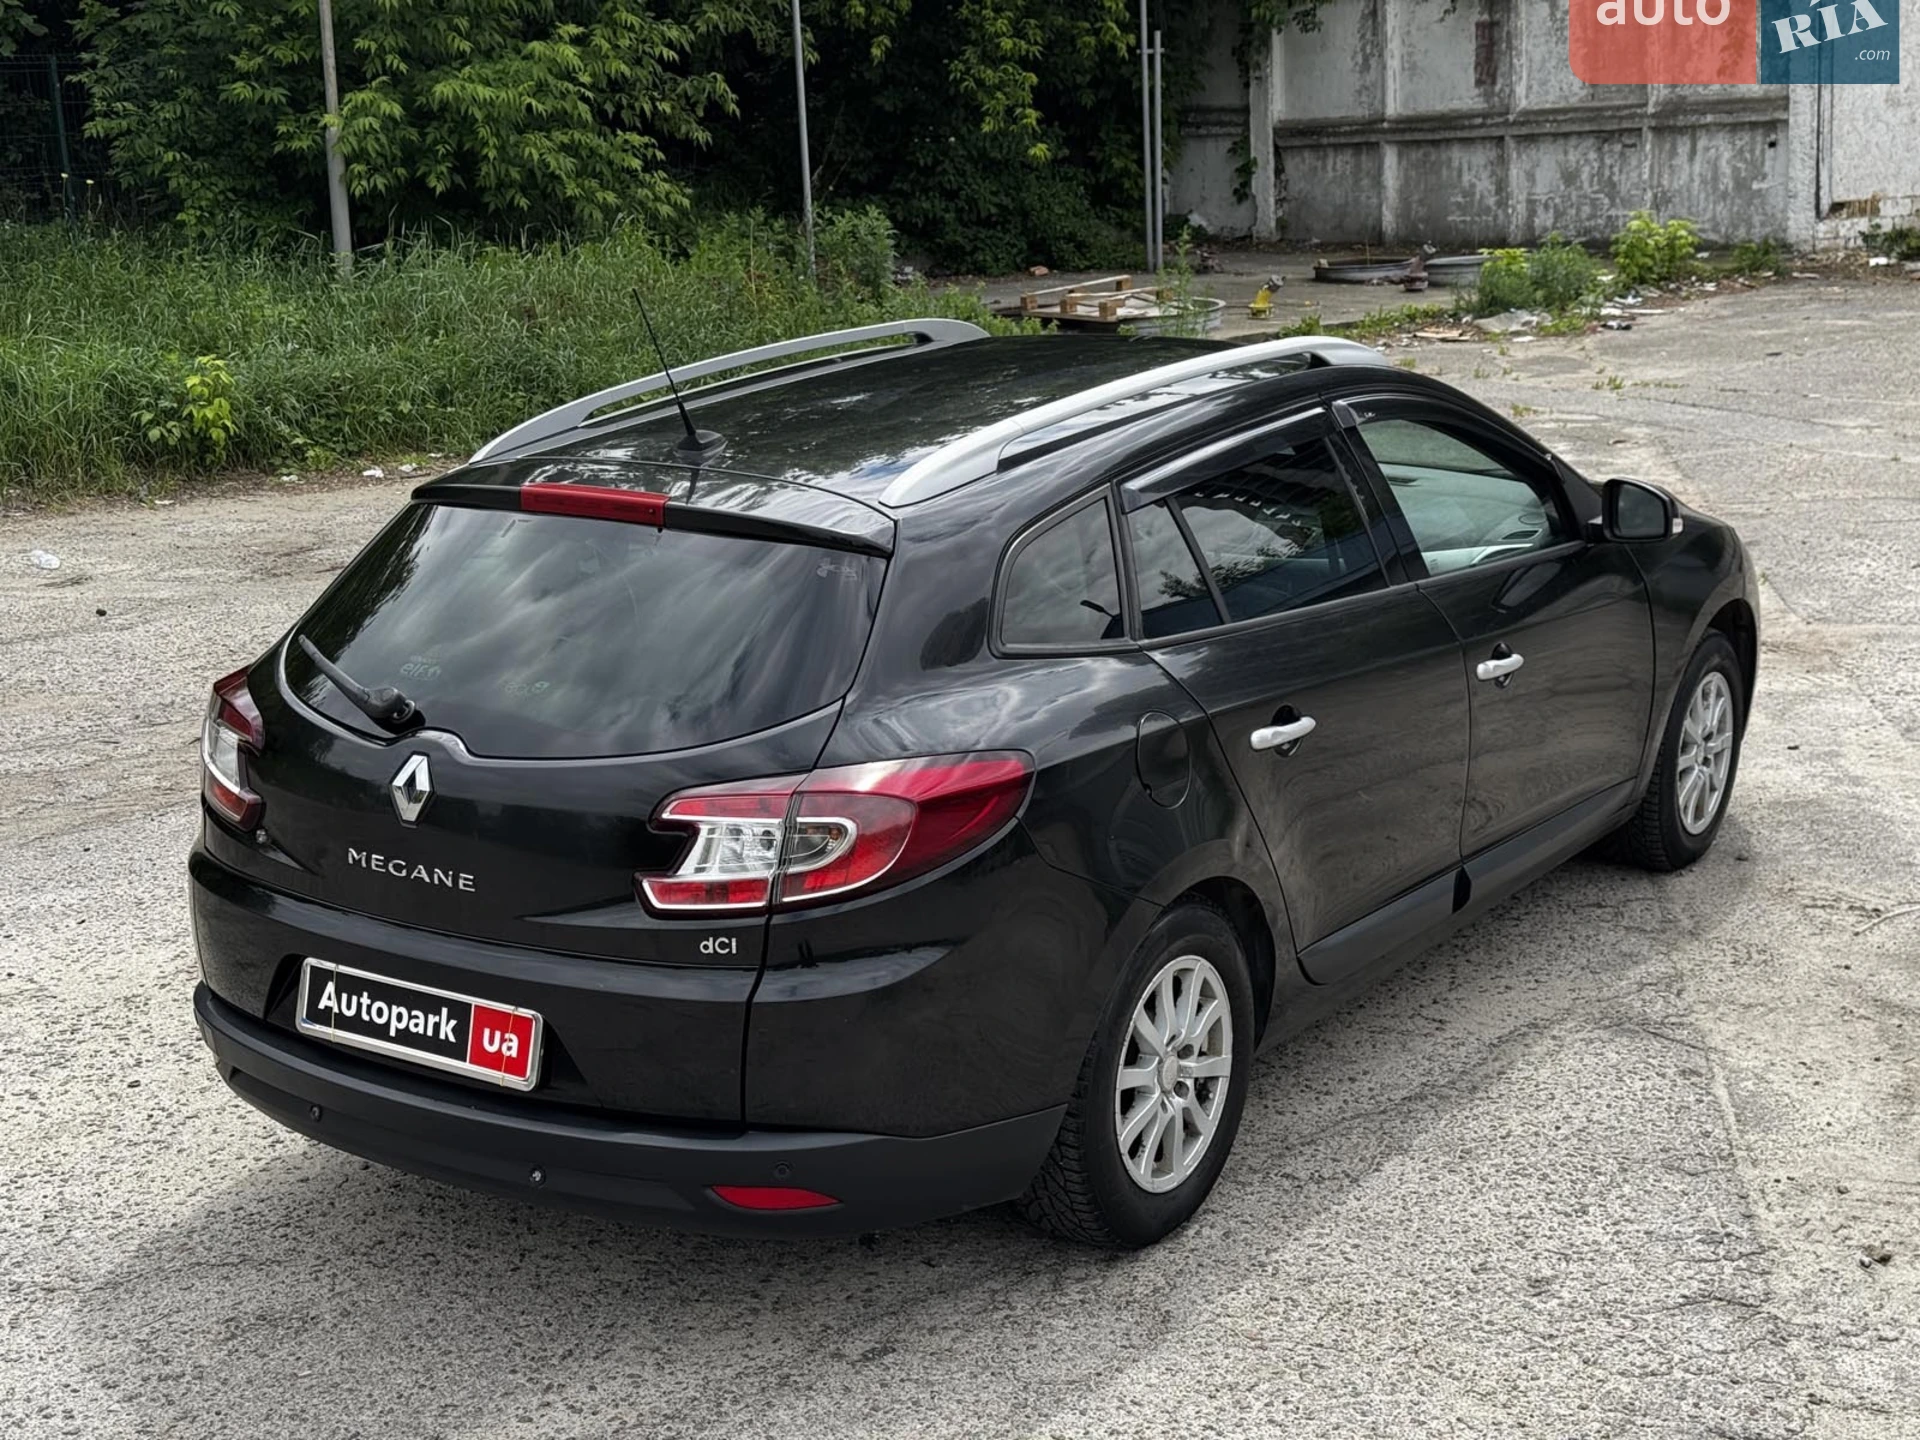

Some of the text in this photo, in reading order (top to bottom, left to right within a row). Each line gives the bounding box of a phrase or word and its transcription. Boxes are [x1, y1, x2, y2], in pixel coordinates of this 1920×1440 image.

[347, 847, 476, 892] MEGANE
[317, 980, 519, 1058] Autopark ua
